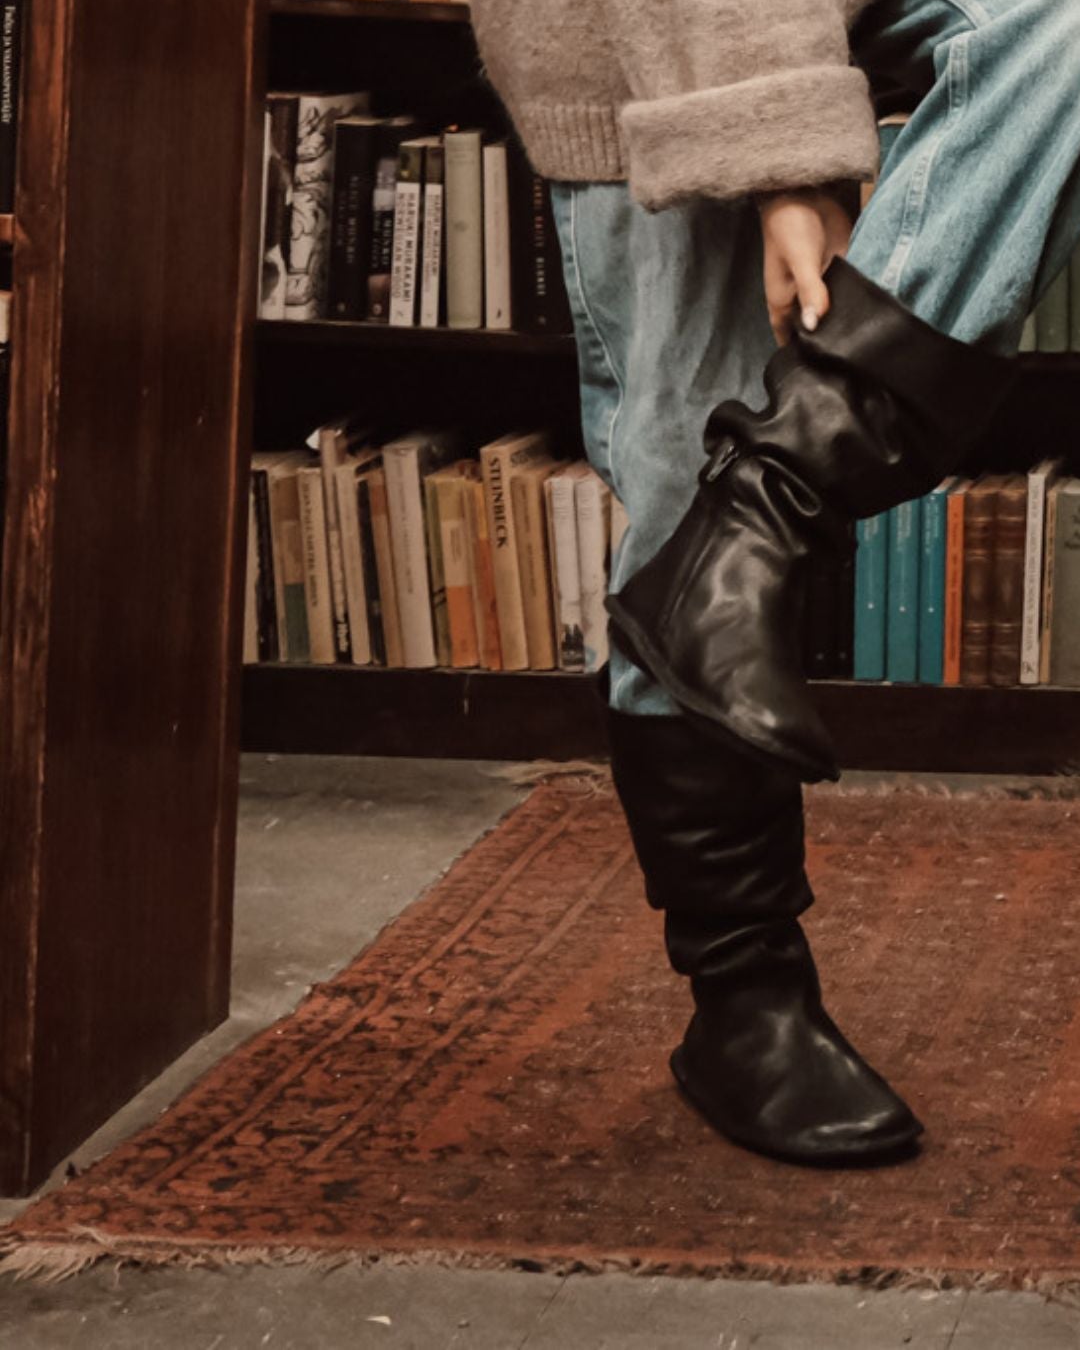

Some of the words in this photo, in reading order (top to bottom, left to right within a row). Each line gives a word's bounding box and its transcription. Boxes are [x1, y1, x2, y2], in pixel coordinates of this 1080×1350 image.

[394, 192, 406, 262] NORWEGIAN
[405, 192, 416, 237] HARUKI
[391, 265, 403, 300] WOOD
[402, 239, 414, 303] MURAKAMI
[488, 456, 510, 550] STEINBECK
